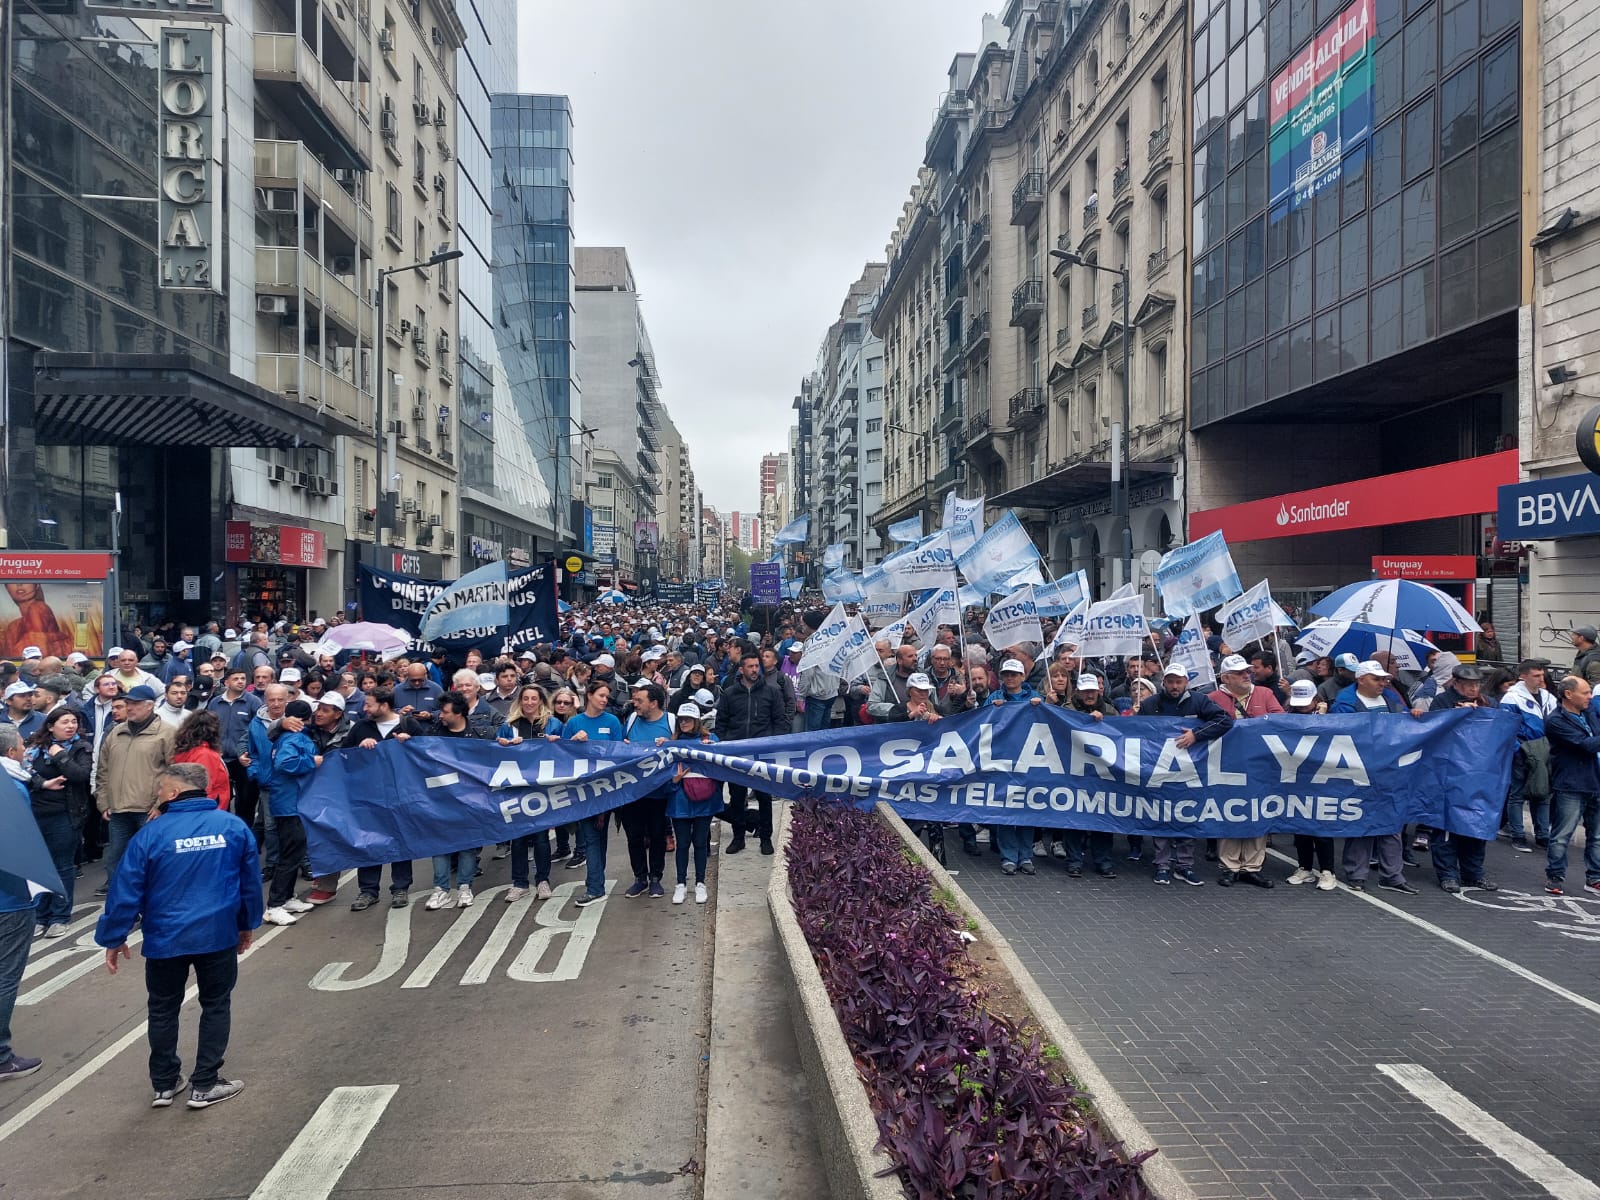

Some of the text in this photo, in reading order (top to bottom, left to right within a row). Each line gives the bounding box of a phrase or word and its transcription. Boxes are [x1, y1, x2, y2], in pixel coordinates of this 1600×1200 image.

[162, 32, 207, 249] LORCA
[163, 257, 173, 283] 1
[194, 259, 210, 283] 2
[1290, 498, 1350, 524] Santander
[1518, 484, 1600, 527] BBVA
[303, 533, 314, 543] HER
[303, 553, 314, 563] DEZ
[1383, 560, 1422, 569] Uruguay
[879, 722, 1247, 788] SALARIAL
[1261, 733, 1371, 787] YA
[500, 771, 638, 824] FOETRA
[825, 774, 872, 797] DE
[878, 777, 939, 803] LAS
[947, 782, 1363, 822] TELECOMUNICACIONES
[175, 834, 226, 849] FOETRA
